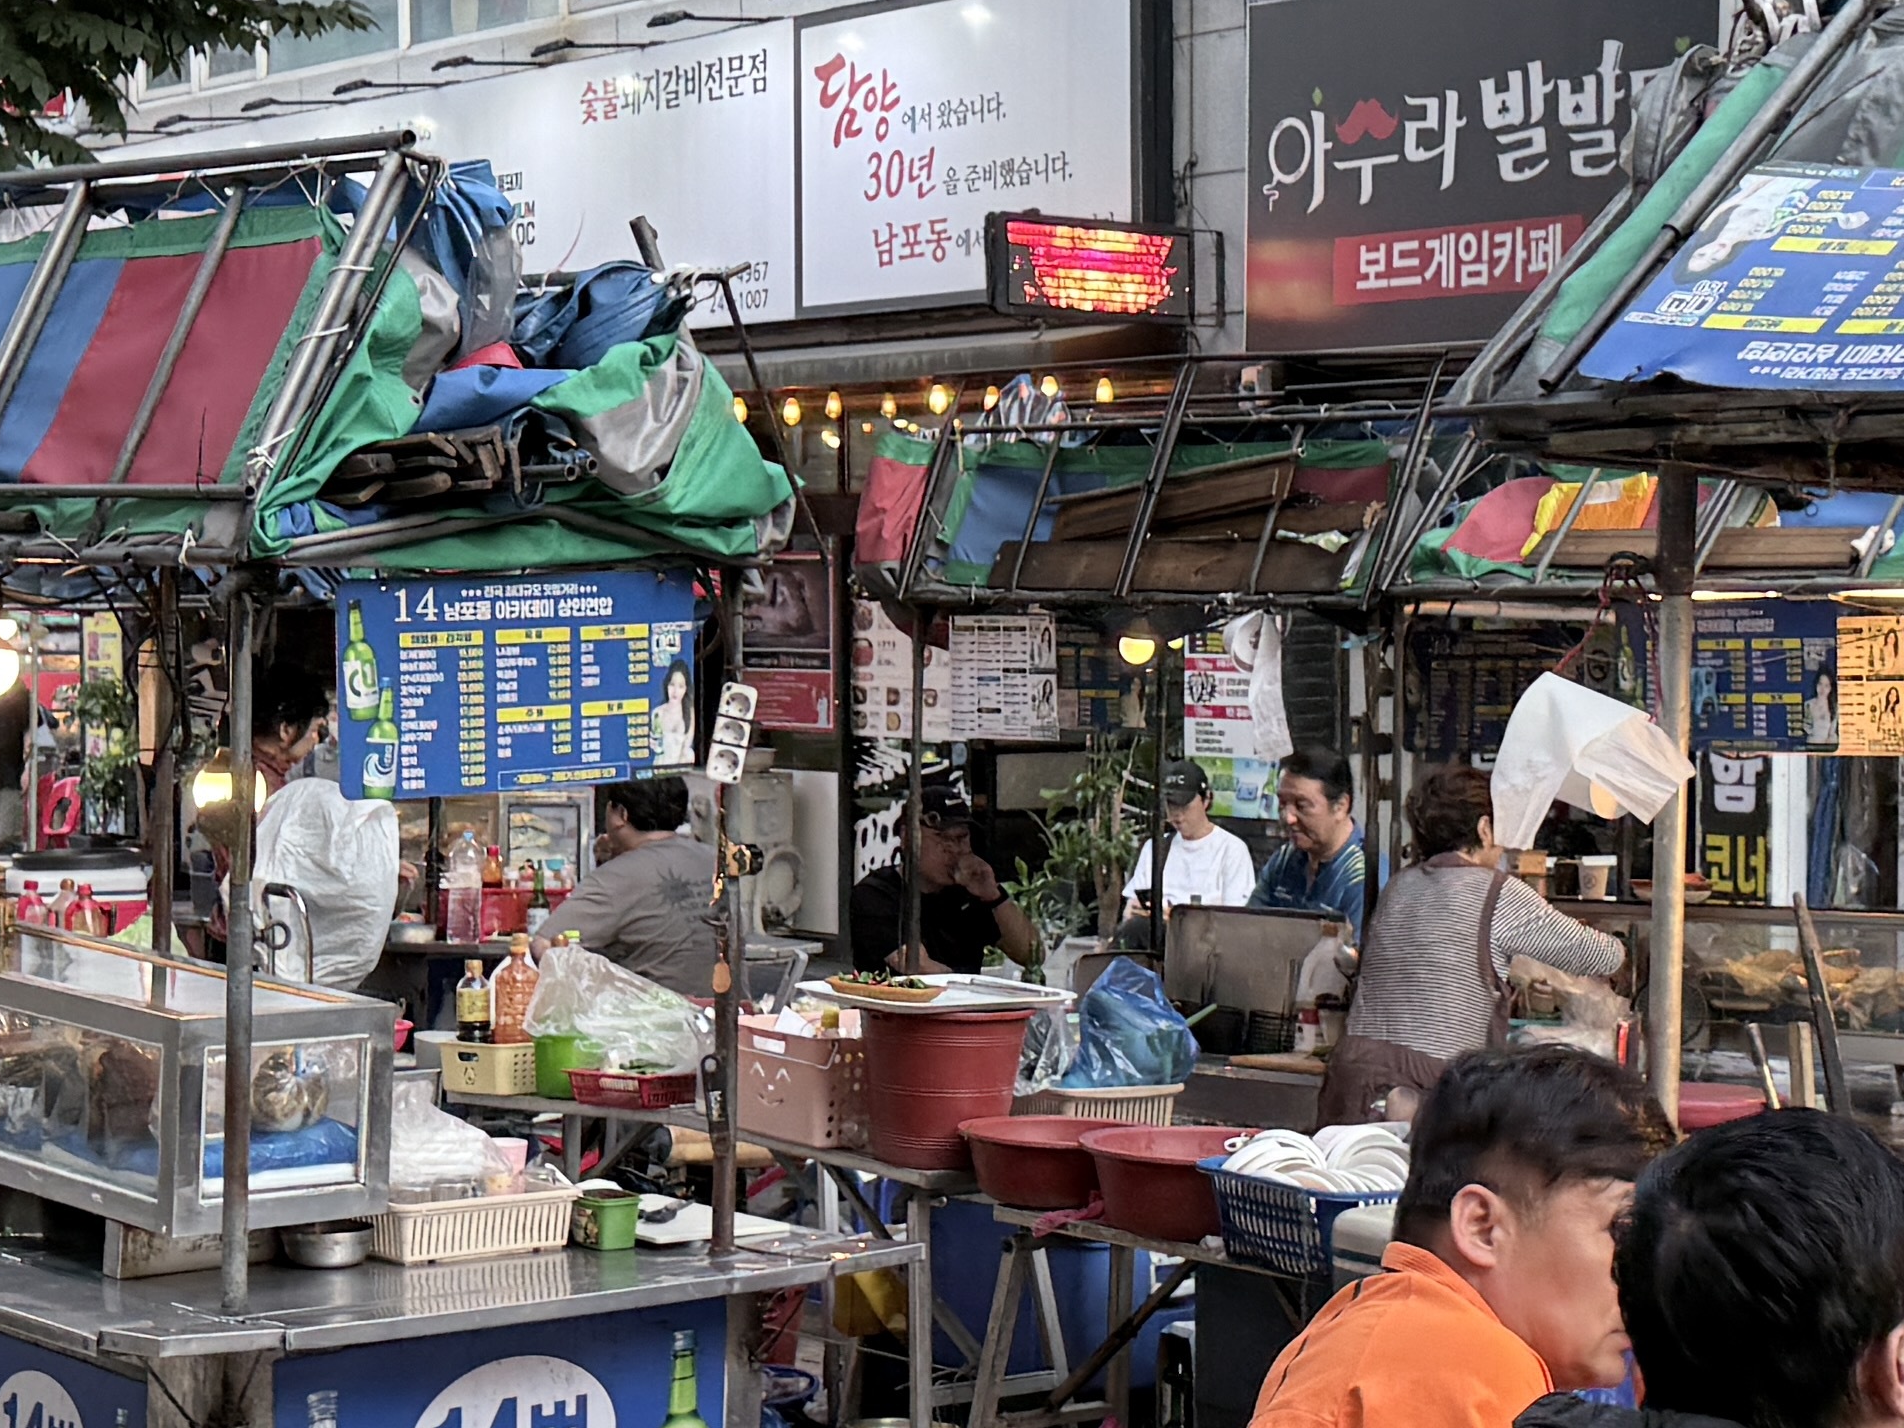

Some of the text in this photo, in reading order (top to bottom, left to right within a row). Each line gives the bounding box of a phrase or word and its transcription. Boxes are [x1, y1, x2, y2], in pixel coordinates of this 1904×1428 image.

[1356, 222, 1563, 290] 보드게임카페
[394, 585, 439, 623] 14
[1704, 833, 1767, 899] 코너
